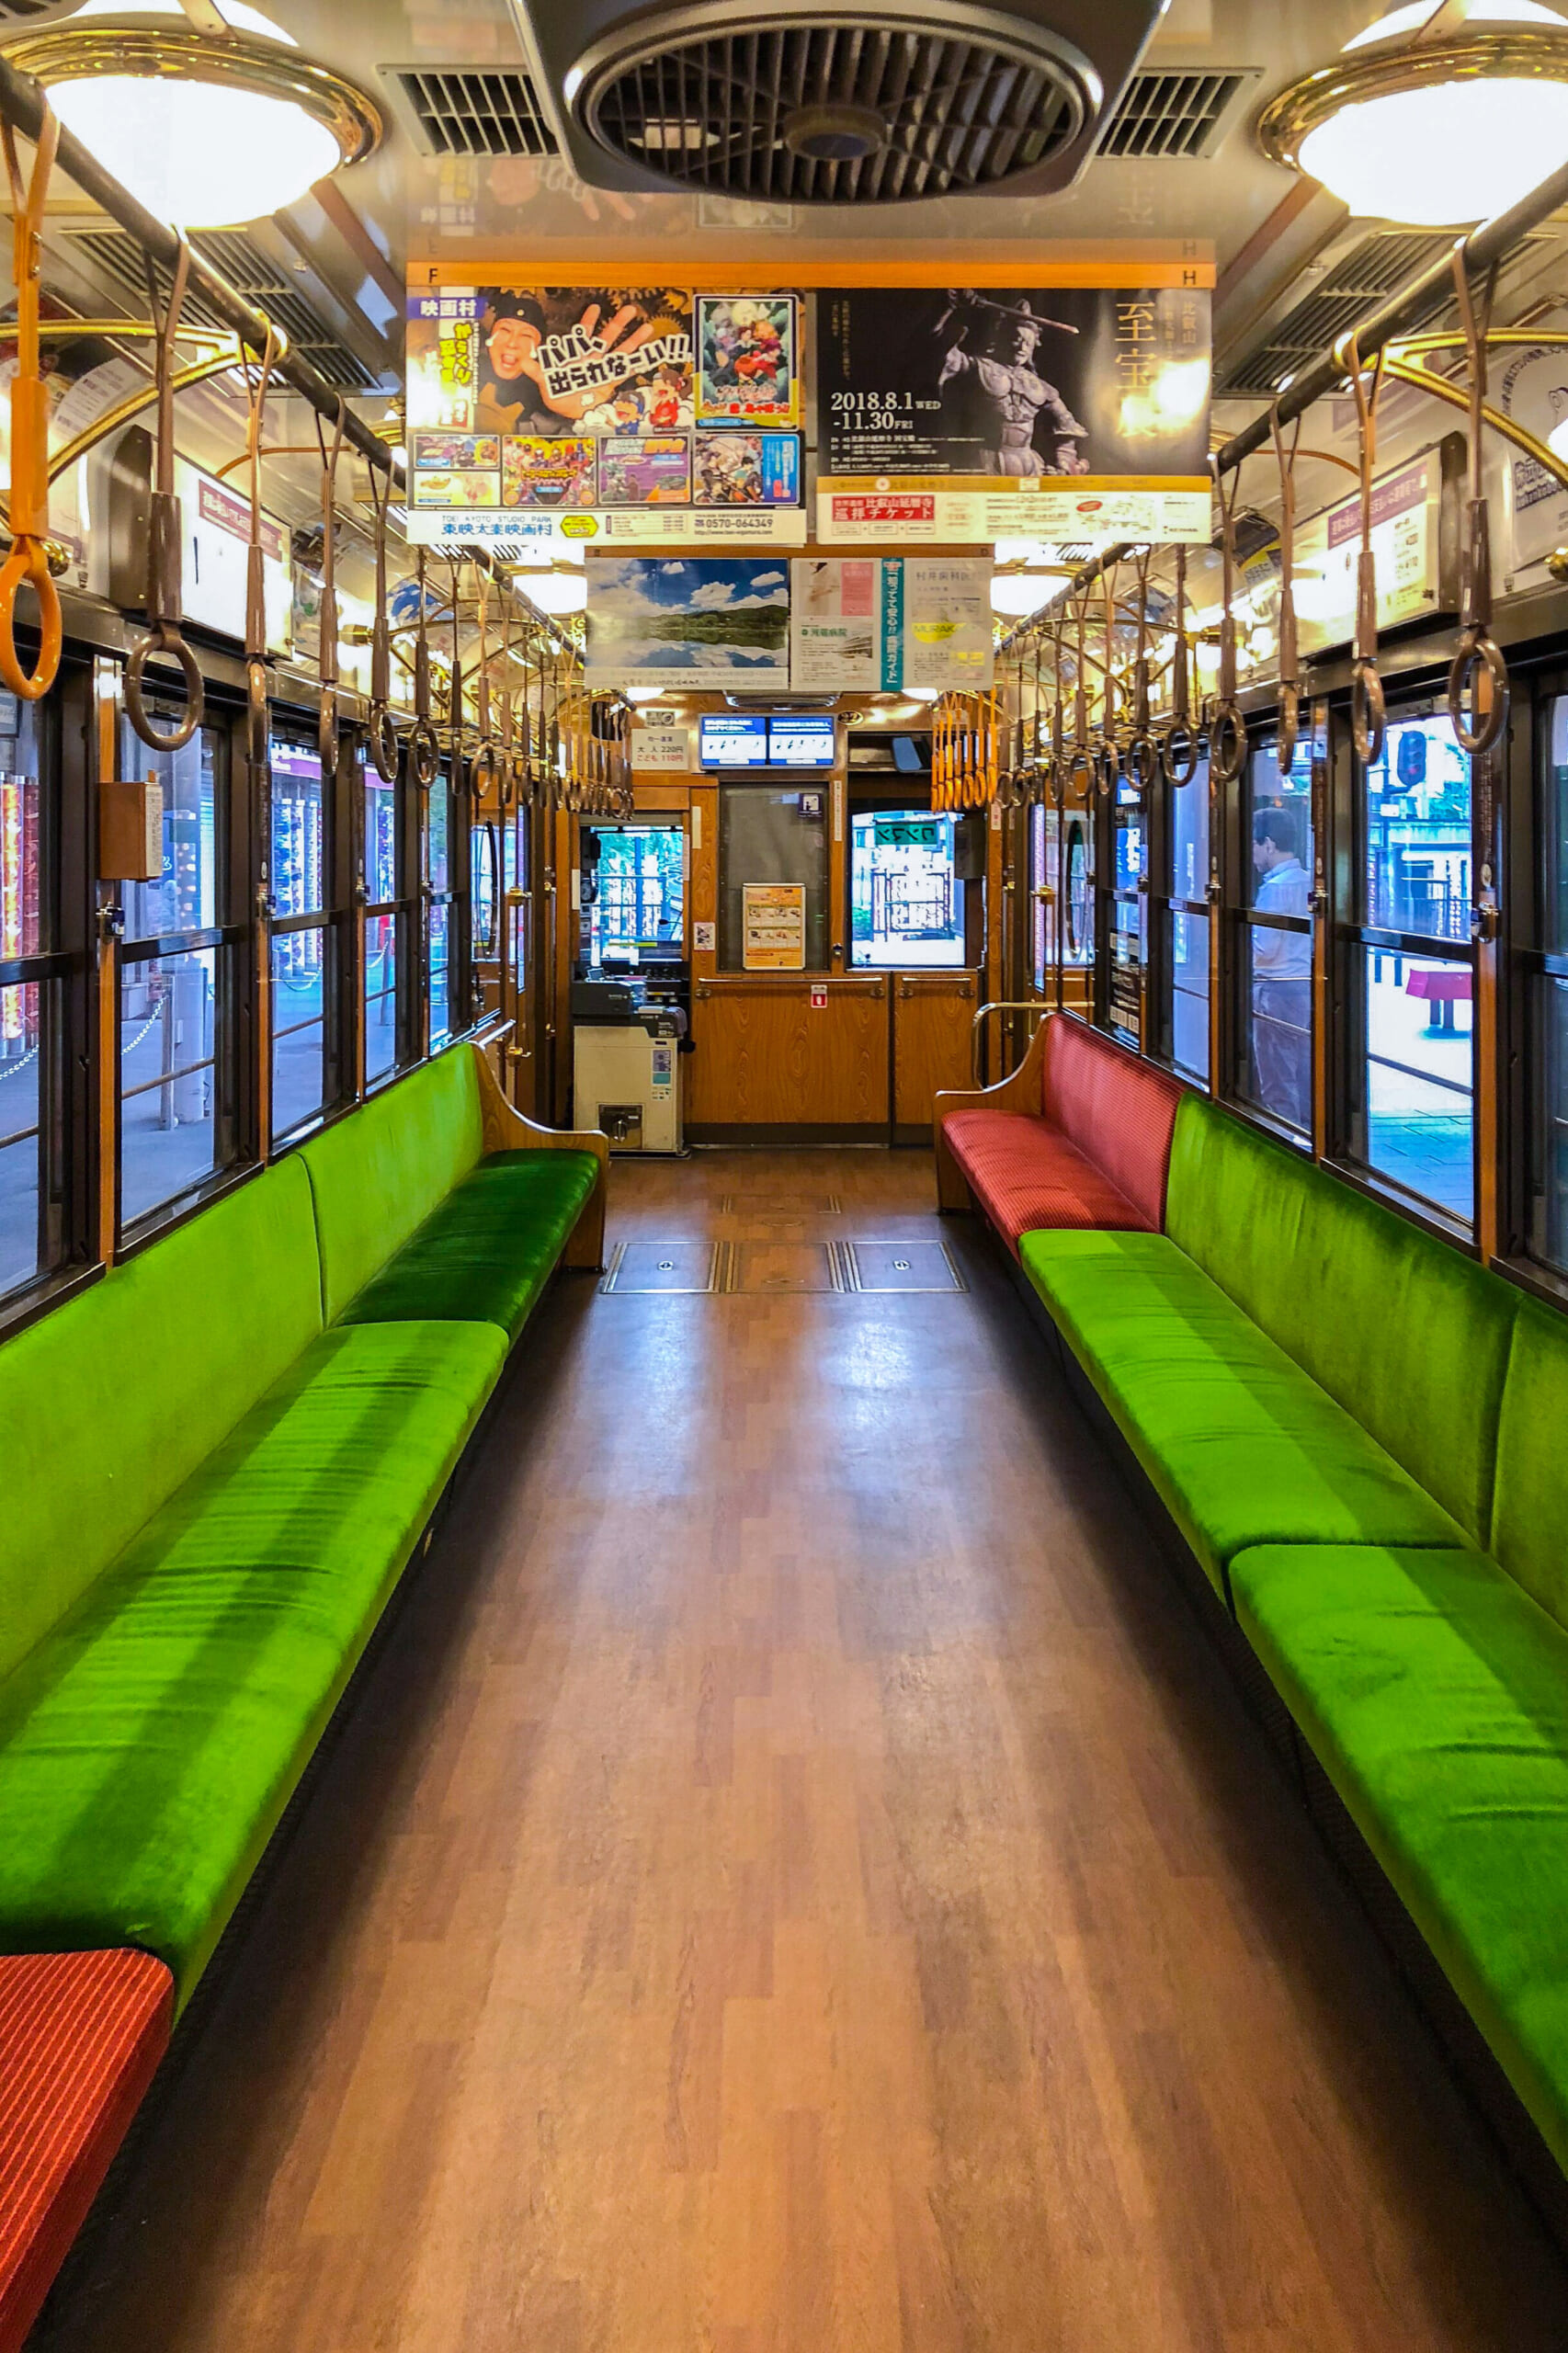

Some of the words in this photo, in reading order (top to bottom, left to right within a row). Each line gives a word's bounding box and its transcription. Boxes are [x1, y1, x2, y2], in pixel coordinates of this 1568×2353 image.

[429, 267, 438, 283] F
[1183, 270, 1197, 285] H
[420, 300, 477, 317] 映画村
[540, 326, 605, 369] パパ、
[831, 392, 914, 410] 2018.8.1
[915, 401, 941, 410] WED
[834, 412, 894, 430] -11.30
[894, 420, 915, 429] FRI
[835, 508, 932, 519] 巡拝チケット
[706, 518, 773, 529] 0570-064349
[661, 745, 684, 754] 220円
[661, 754, 684, 762] 110円
